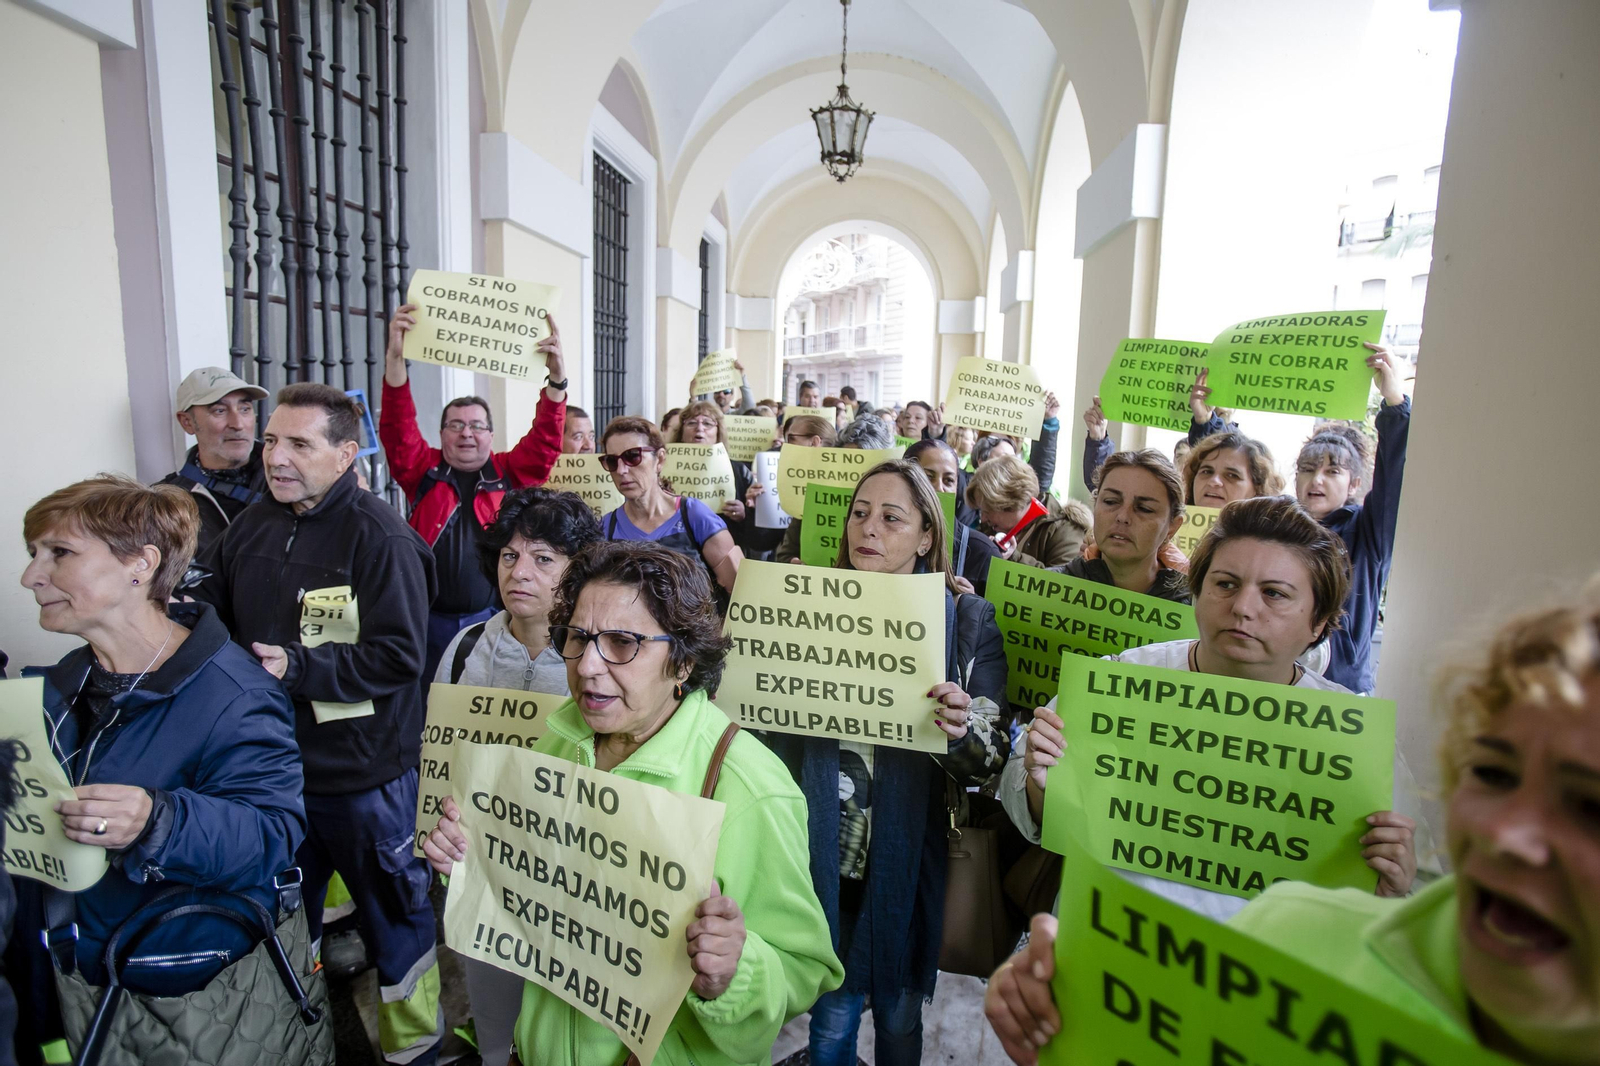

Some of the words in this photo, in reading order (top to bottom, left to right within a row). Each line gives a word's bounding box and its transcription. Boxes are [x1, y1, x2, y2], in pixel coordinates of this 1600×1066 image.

[468, 277, 487, 288] SI
[492, 280, 516, 293] NO
[423, 286, 519, 313] COBRAMOS
[524, 305, 548, 320] NO
[426, 305, 539, 338] TRABAJAMOS
[1235, 315, 1368, 330] LIMPIADORAS
[436, 328, 523, 356] EXPERTUS
[1231, 334, 1254, 344] DE
[1259, 334, 1359, 348] EXPERTUS
[422, 347, 528, 377] !!CULPABLE!!
[986, 362, 999, 372] SI
[1002, 366, 1019, 376] NO
[1120, 358, 1136, 369] DE
[1229, 352, 1262, 365] SIN
[1269, 354, 1348, 371] COBRAR
[958, 373, 1020, 390] COBRAMOS
[1025, 384, 1042, 394] NO
[1118, 376, 1142, 388] SIN
[1235, 374, 1335, 392] NUESTRAS
[958, 387, 1035, 407] TRABAJAMOS
[1236, 395, 1326, 414] NOMINAS
[964, 402, 1023, 420] EXPERTUS
[1123, 411, 1190, 431] NOMINAS
[954, 415, 1028, 436] !!CULPABLE!!
[566, 459, 585, 467] NO
[677, 462, 708, 471] PAGA
[821, 452, 836, 462] SI
[843, 454, 864, 464] NO
[816, 514, 836, 527] DE
[784, 574, 812, 595] SI
[822, 578, 862, 599] NO
[1003, 570, 1182, 631] LIMPIADORAS
[1003, 601, 1033, 623] DE
[729, 602, 873, 636] COBRAMOS
[884, 619, 926, 641] NO
[1007, 630, 1048, 653] SIN
[733, 637, 917, 674] TRABAJAMOS
[756, 672, 894, 707] EXPERTUS
[469, 696, 494, 715] SI
[500, 698, 538, 720] NO
[1087, 670, 1365, 735] LIMPIADORAS
[740, 703, 913, 743] !!CULPABLE!!
[1090, 712, 1136, 741] DE
[1149, 722, 1353, 781] EXPERTUS
[534, 766, 566, 799] SI
[577, 777, 620, 816] NO
[1094, 754, 1159, 787] SIN
[1173, 770, 1336, 826] COBRAR
[1108, 796, 1310, 862] NUESTRAS
[471, 791, 628, 869] COBRAMOS
[639, 850, 686, 892] NO
[1111, 838, 1291, 893] NOMINA
[484, 833, 670, 939] TRABAJAMOS
[502, 886, 643, 977] EXPERTUS
[473, 923, 652, 1045] !!CULPABLE!!
[1102, 971, 1182, 1057] DE
